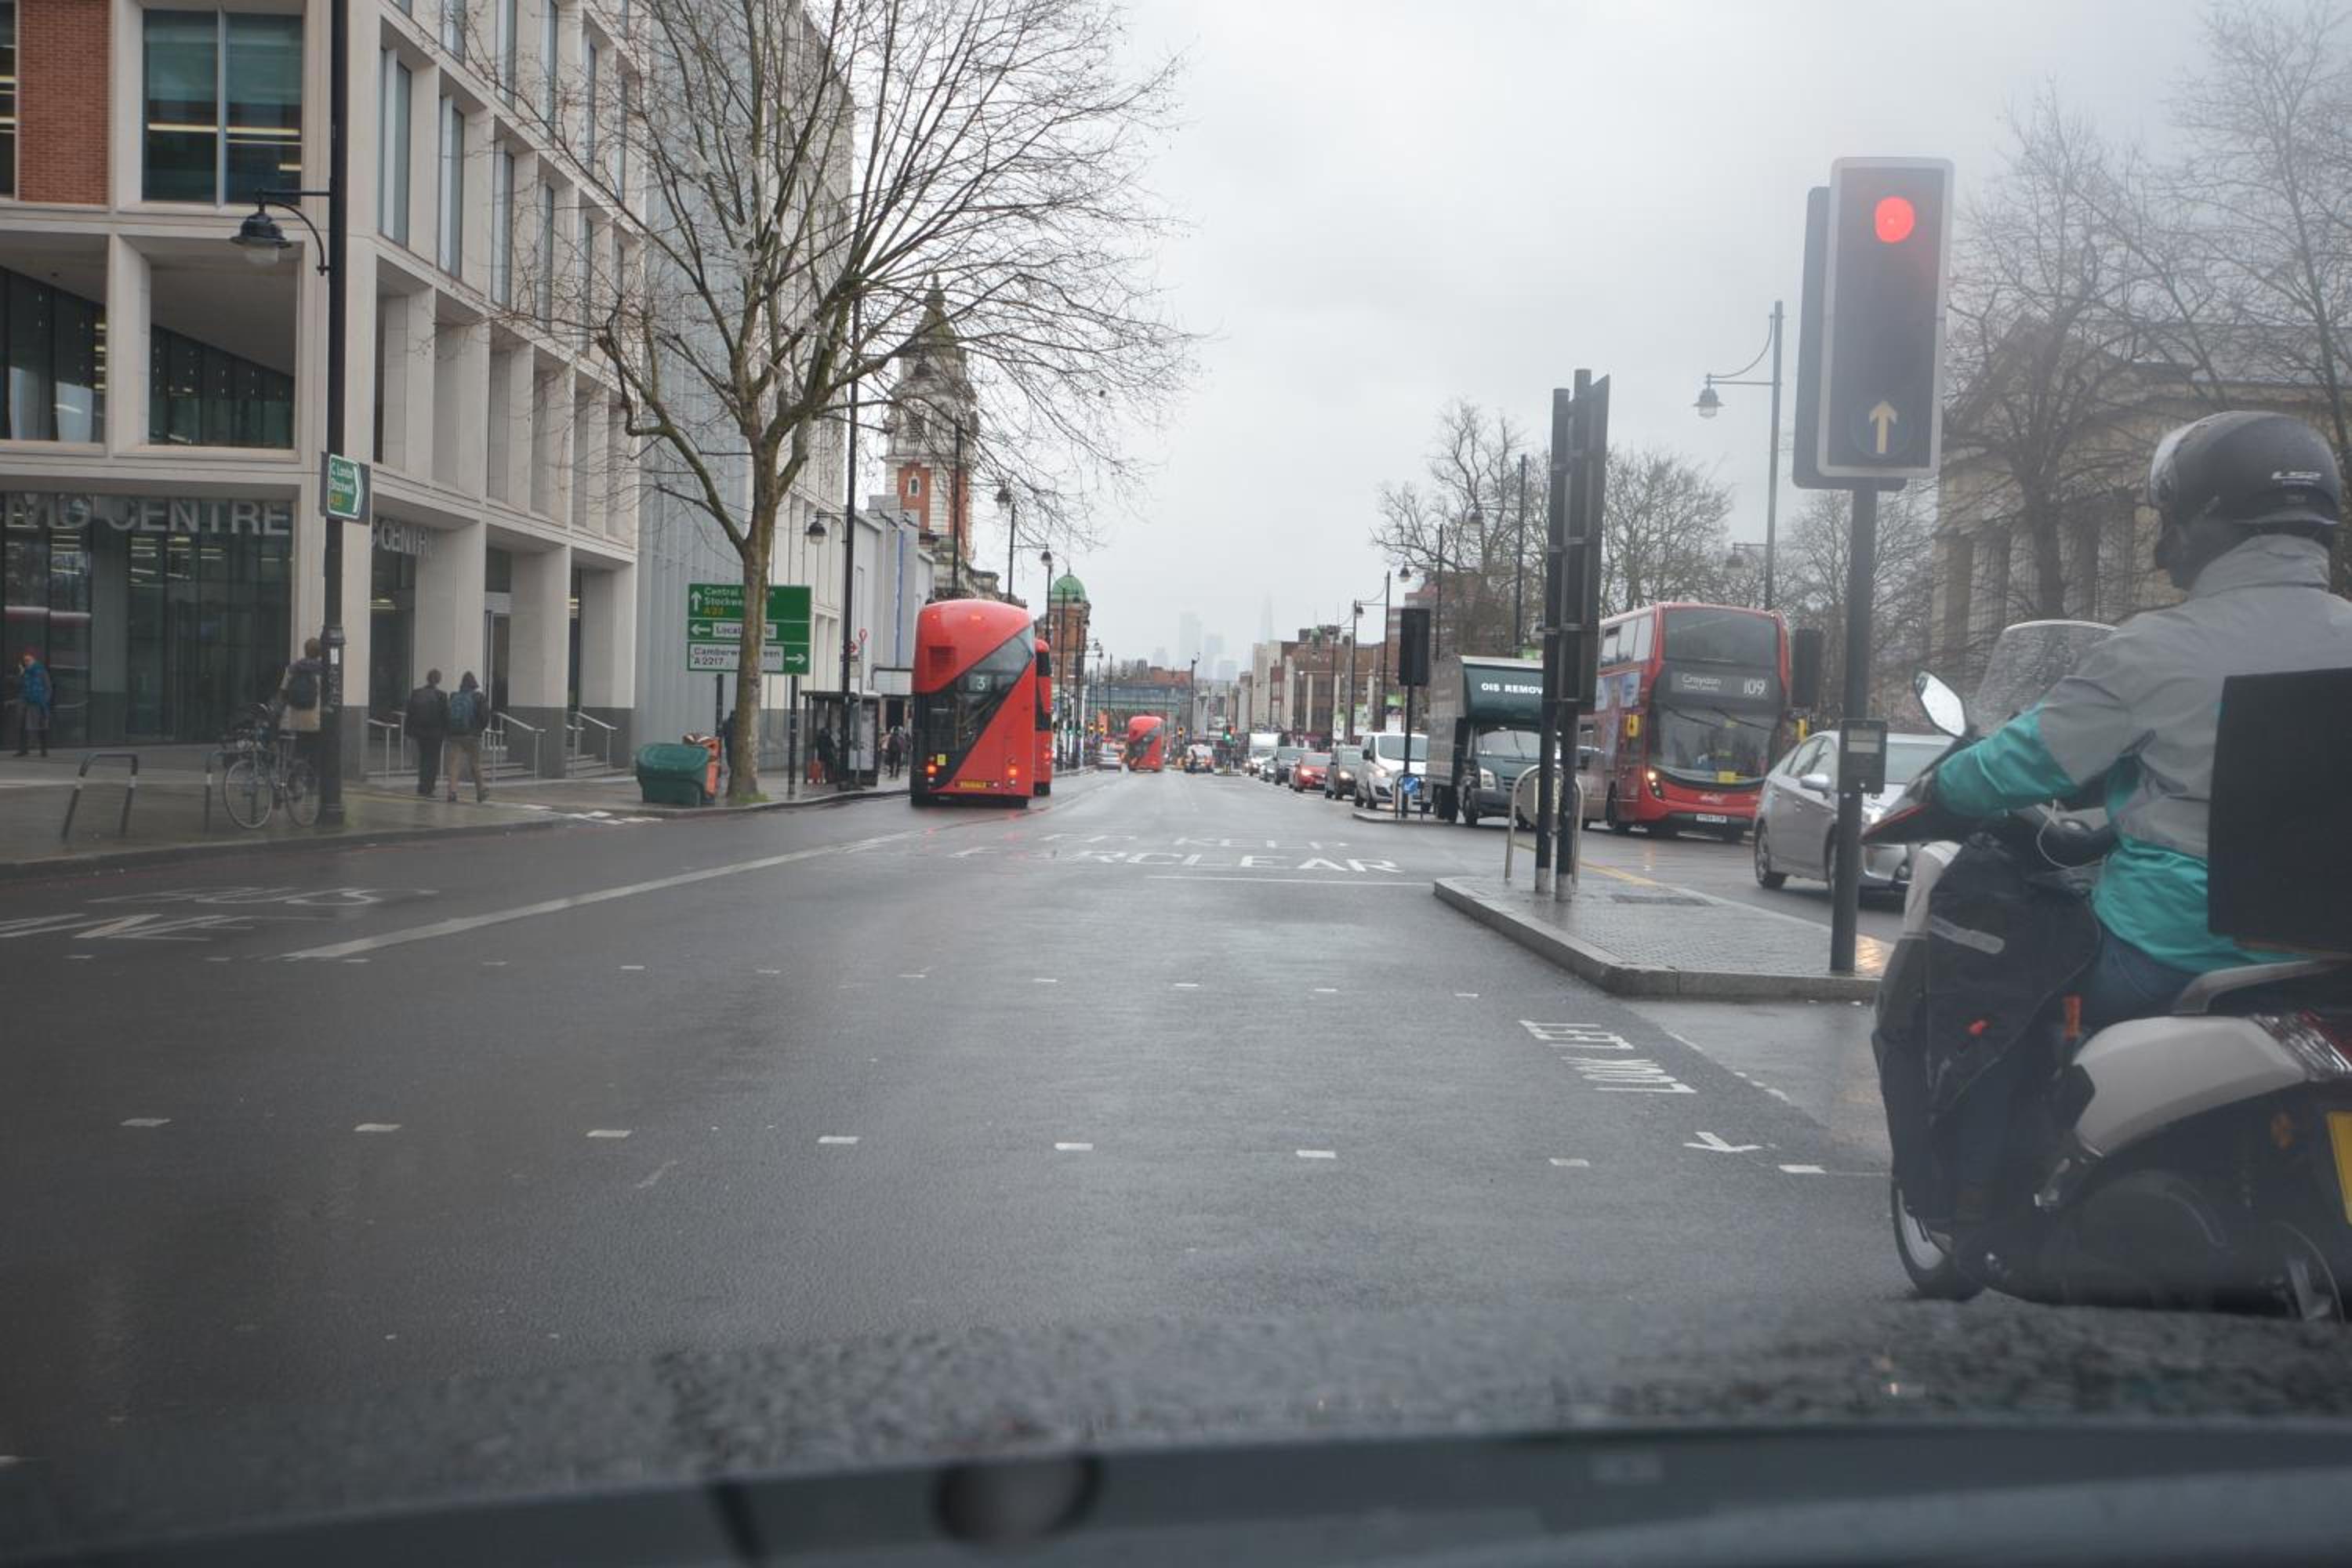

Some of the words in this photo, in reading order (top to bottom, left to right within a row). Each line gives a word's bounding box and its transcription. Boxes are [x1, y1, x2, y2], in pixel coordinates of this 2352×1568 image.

[107, 497, 290, 535] CENTRE
[704, 597, 744, 606] Stockwe
[715, 626, 742, 635] Local
[694, 647, 740, 656] Camberw
[1504, 684, 1543, 695] REMOV
[1744, 677, 1766, 695] 109
[1127, 852, 1403, 873] CLEAR
